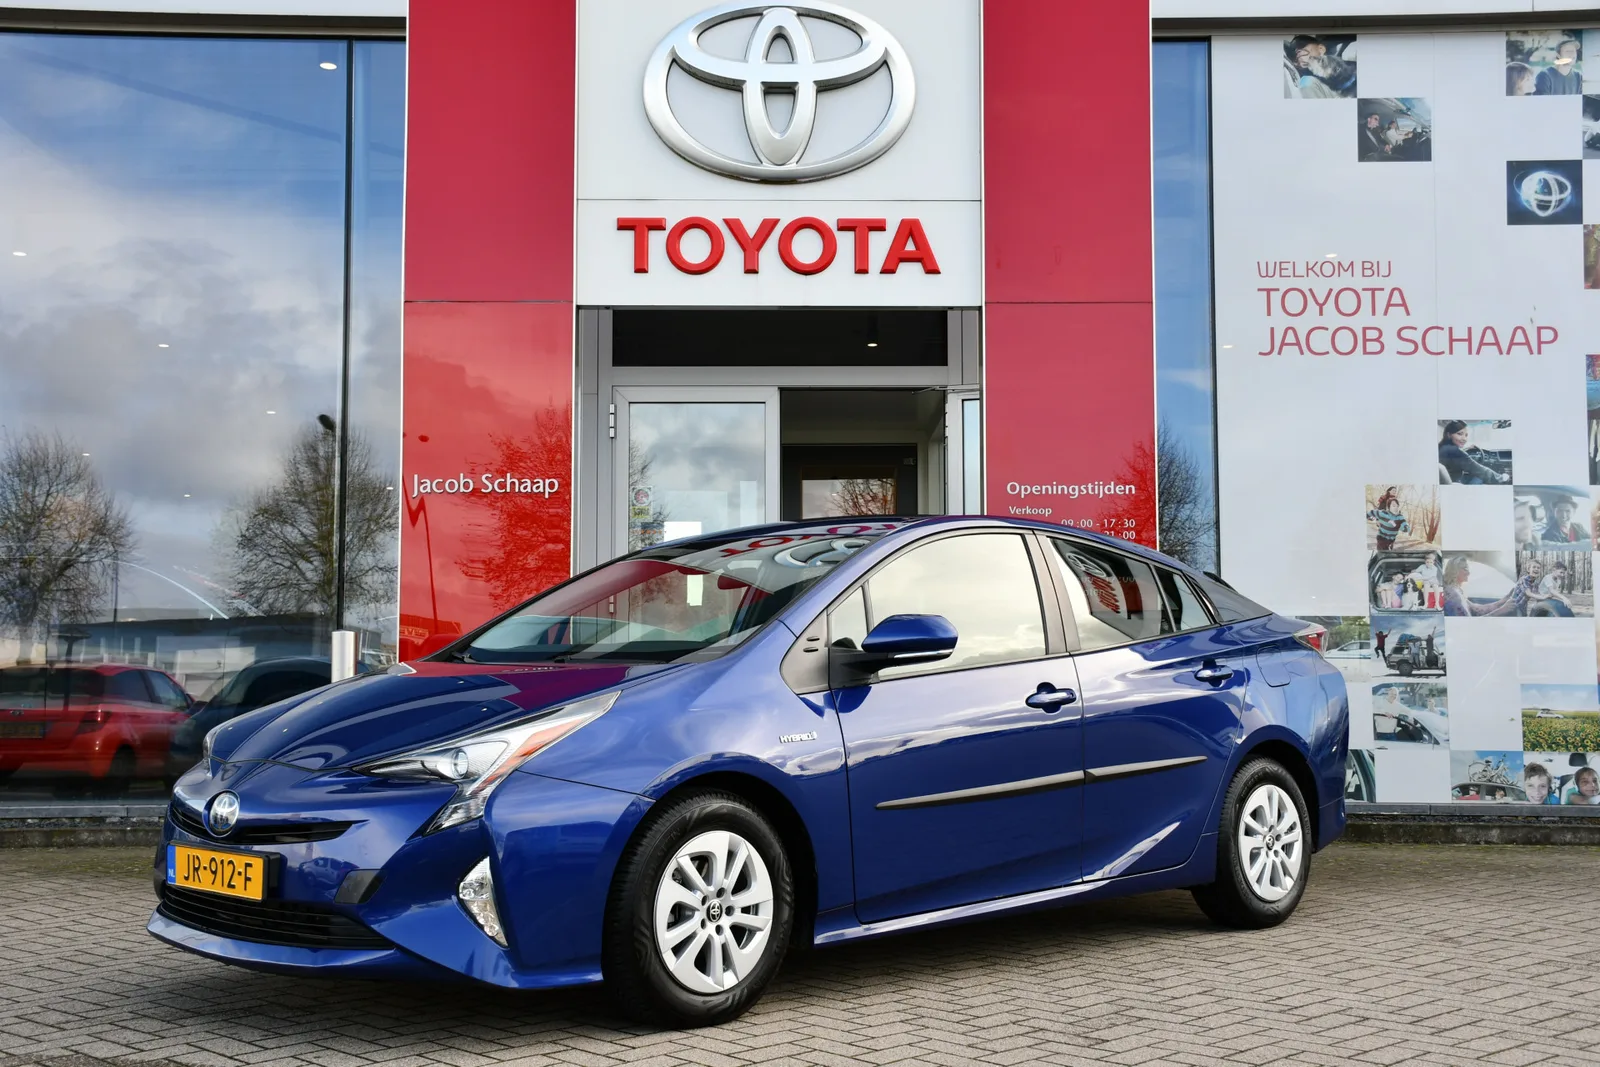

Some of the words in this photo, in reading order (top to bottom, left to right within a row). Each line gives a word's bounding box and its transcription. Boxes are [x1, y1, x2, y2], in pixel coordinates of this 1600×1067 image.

[616, 216, 941, 275] TOYOTA
[1257, 260, 1355, 278] WELKOM
[1361, 260, 1392, 278] BIJ
[1257, 287, 1411, 317] TOYOTA
[1258, 326, 1385, 356] JACOB
[1395, 326, 1559, 356] SCHAAP
[412, 472, 474, 498] Jacob
[481, 472, 559, 498] Schaap
[1006, 481, 1136, 498] Openingstijden
[1009, 505, 1052, 517] Verkoop
[779, 732, 813, 743] HYBRID
[183, 853, 253, 891] JR-912-F
